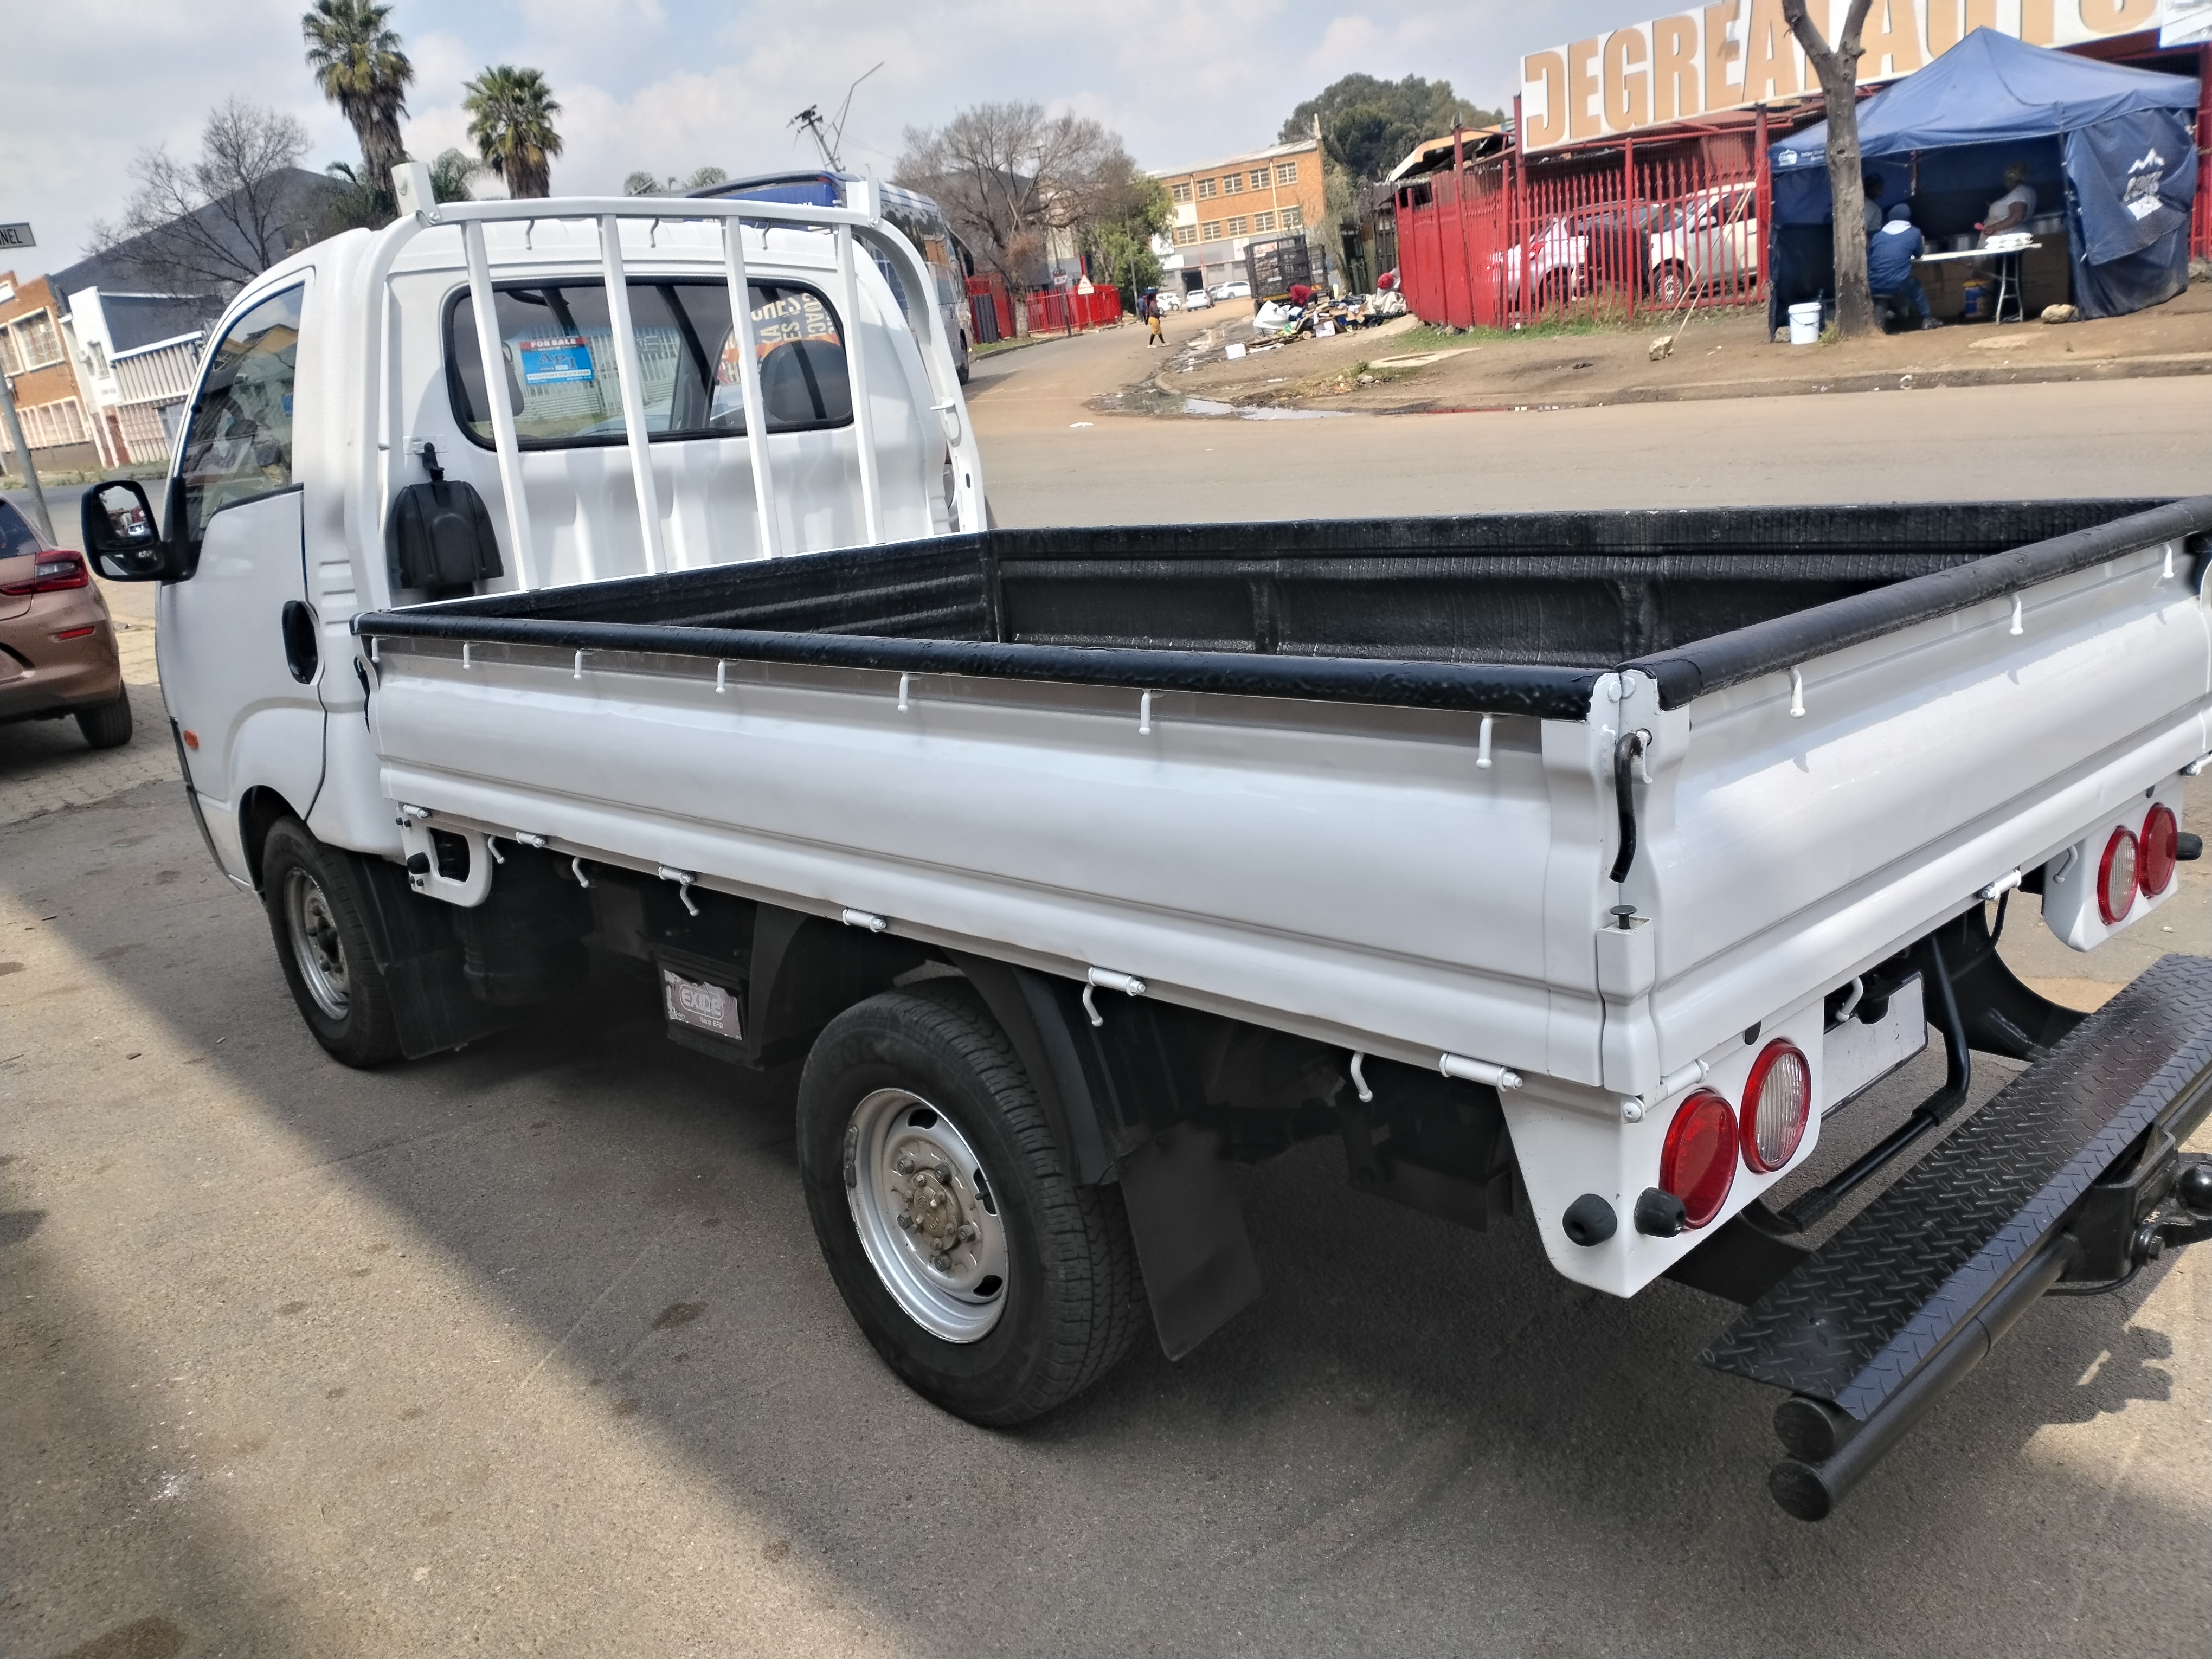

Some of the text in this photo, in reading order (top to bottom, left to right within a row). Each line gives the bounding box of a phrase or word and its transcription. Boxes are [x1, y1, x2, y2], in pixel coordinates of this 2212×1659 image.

[0, 228, 23, 245] NEL
[530, 338, 576, 348] FOR SALE
[538, 352, 578, 370] API
[699, 1015, 712, 1026] Nano
